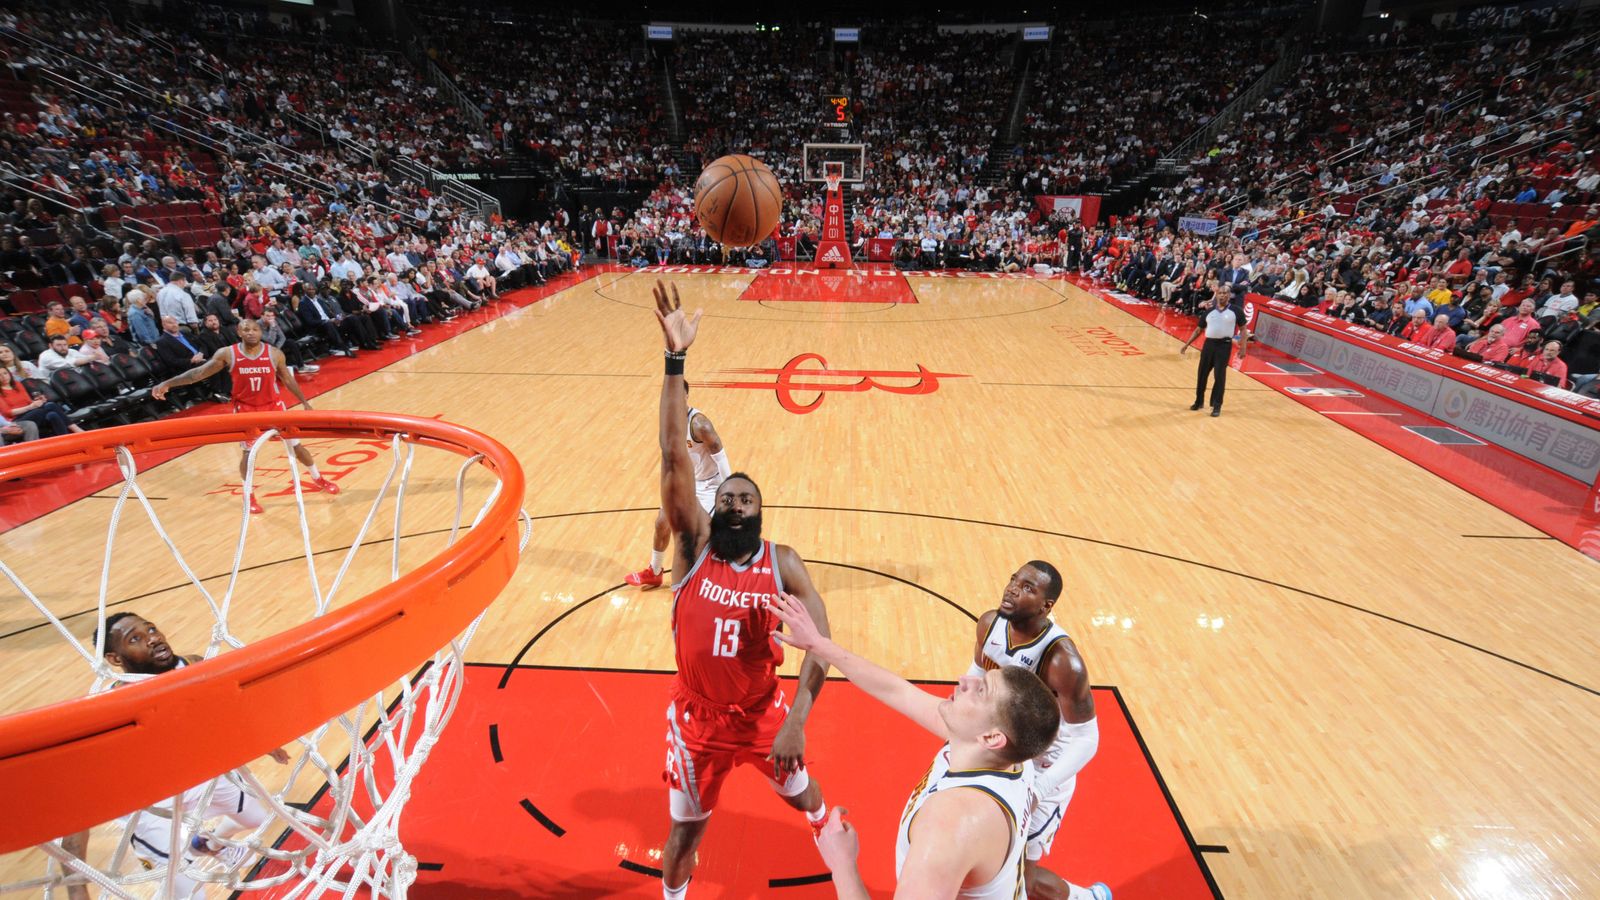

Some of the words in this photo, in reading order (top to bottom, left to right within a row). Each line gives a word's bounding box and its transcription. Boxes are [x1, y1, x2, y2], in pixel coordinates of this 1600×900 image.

[836, 105, 845, 121] 5
[1081, 326, 1146, 357] TOYOTA
[238, 366, 271, 375] ROCKETS
[249, 376, 262, 392] 17
[698, 576, 772, 610] ROCKETS
[712, 616, 741, 658] 13
